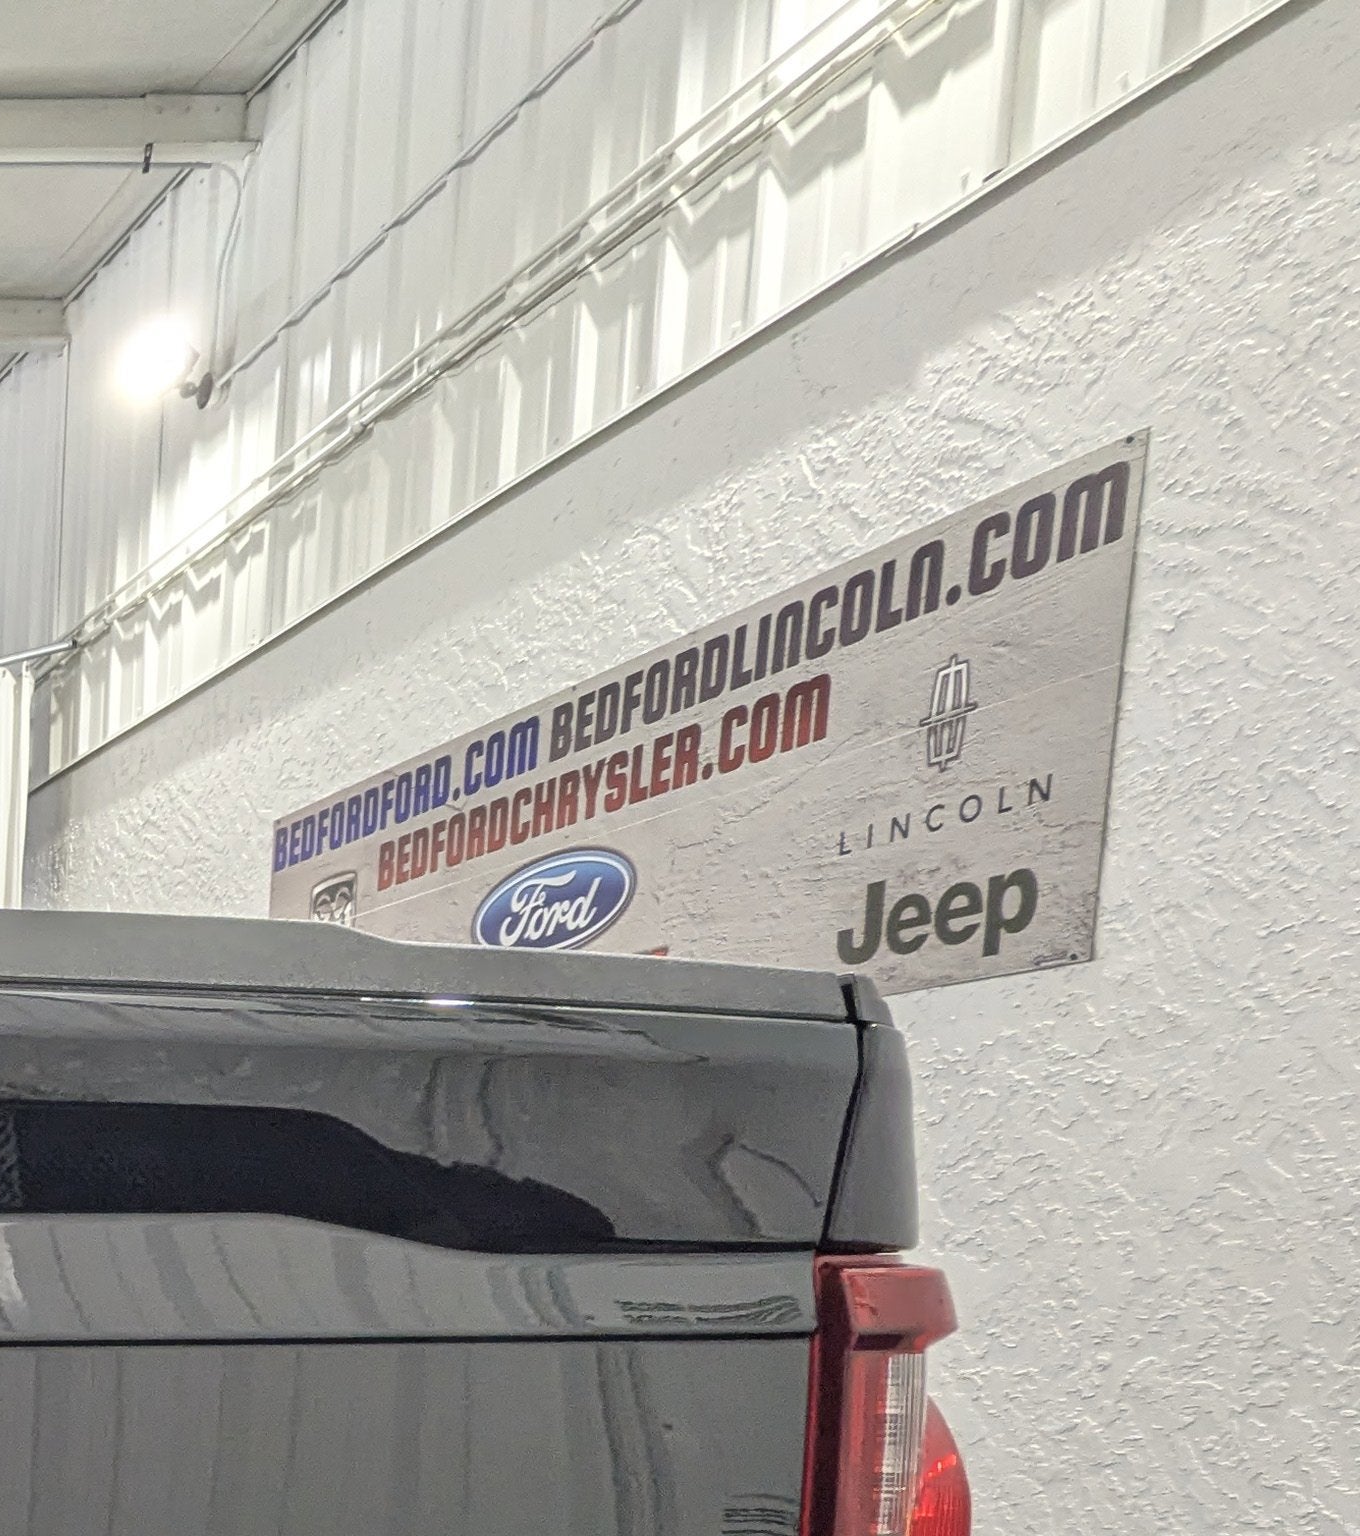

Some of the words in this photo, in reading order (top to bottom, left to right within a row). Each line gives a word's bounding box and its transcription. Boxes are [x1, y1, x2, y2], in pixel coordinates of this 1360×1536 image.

[274, 715, 540, 872] BEDFORDFORD.COM
[548, 460, 1131, 761] BEDFORDLINCOLN.COM
[377, 673, 831, 892] BEDFORDCHRYSLER.COM
[837, 772, 1055, 857] LINCOLN
[499, 869, 603, 947] Ford
[836, 866, 1039, 965] Jeep
